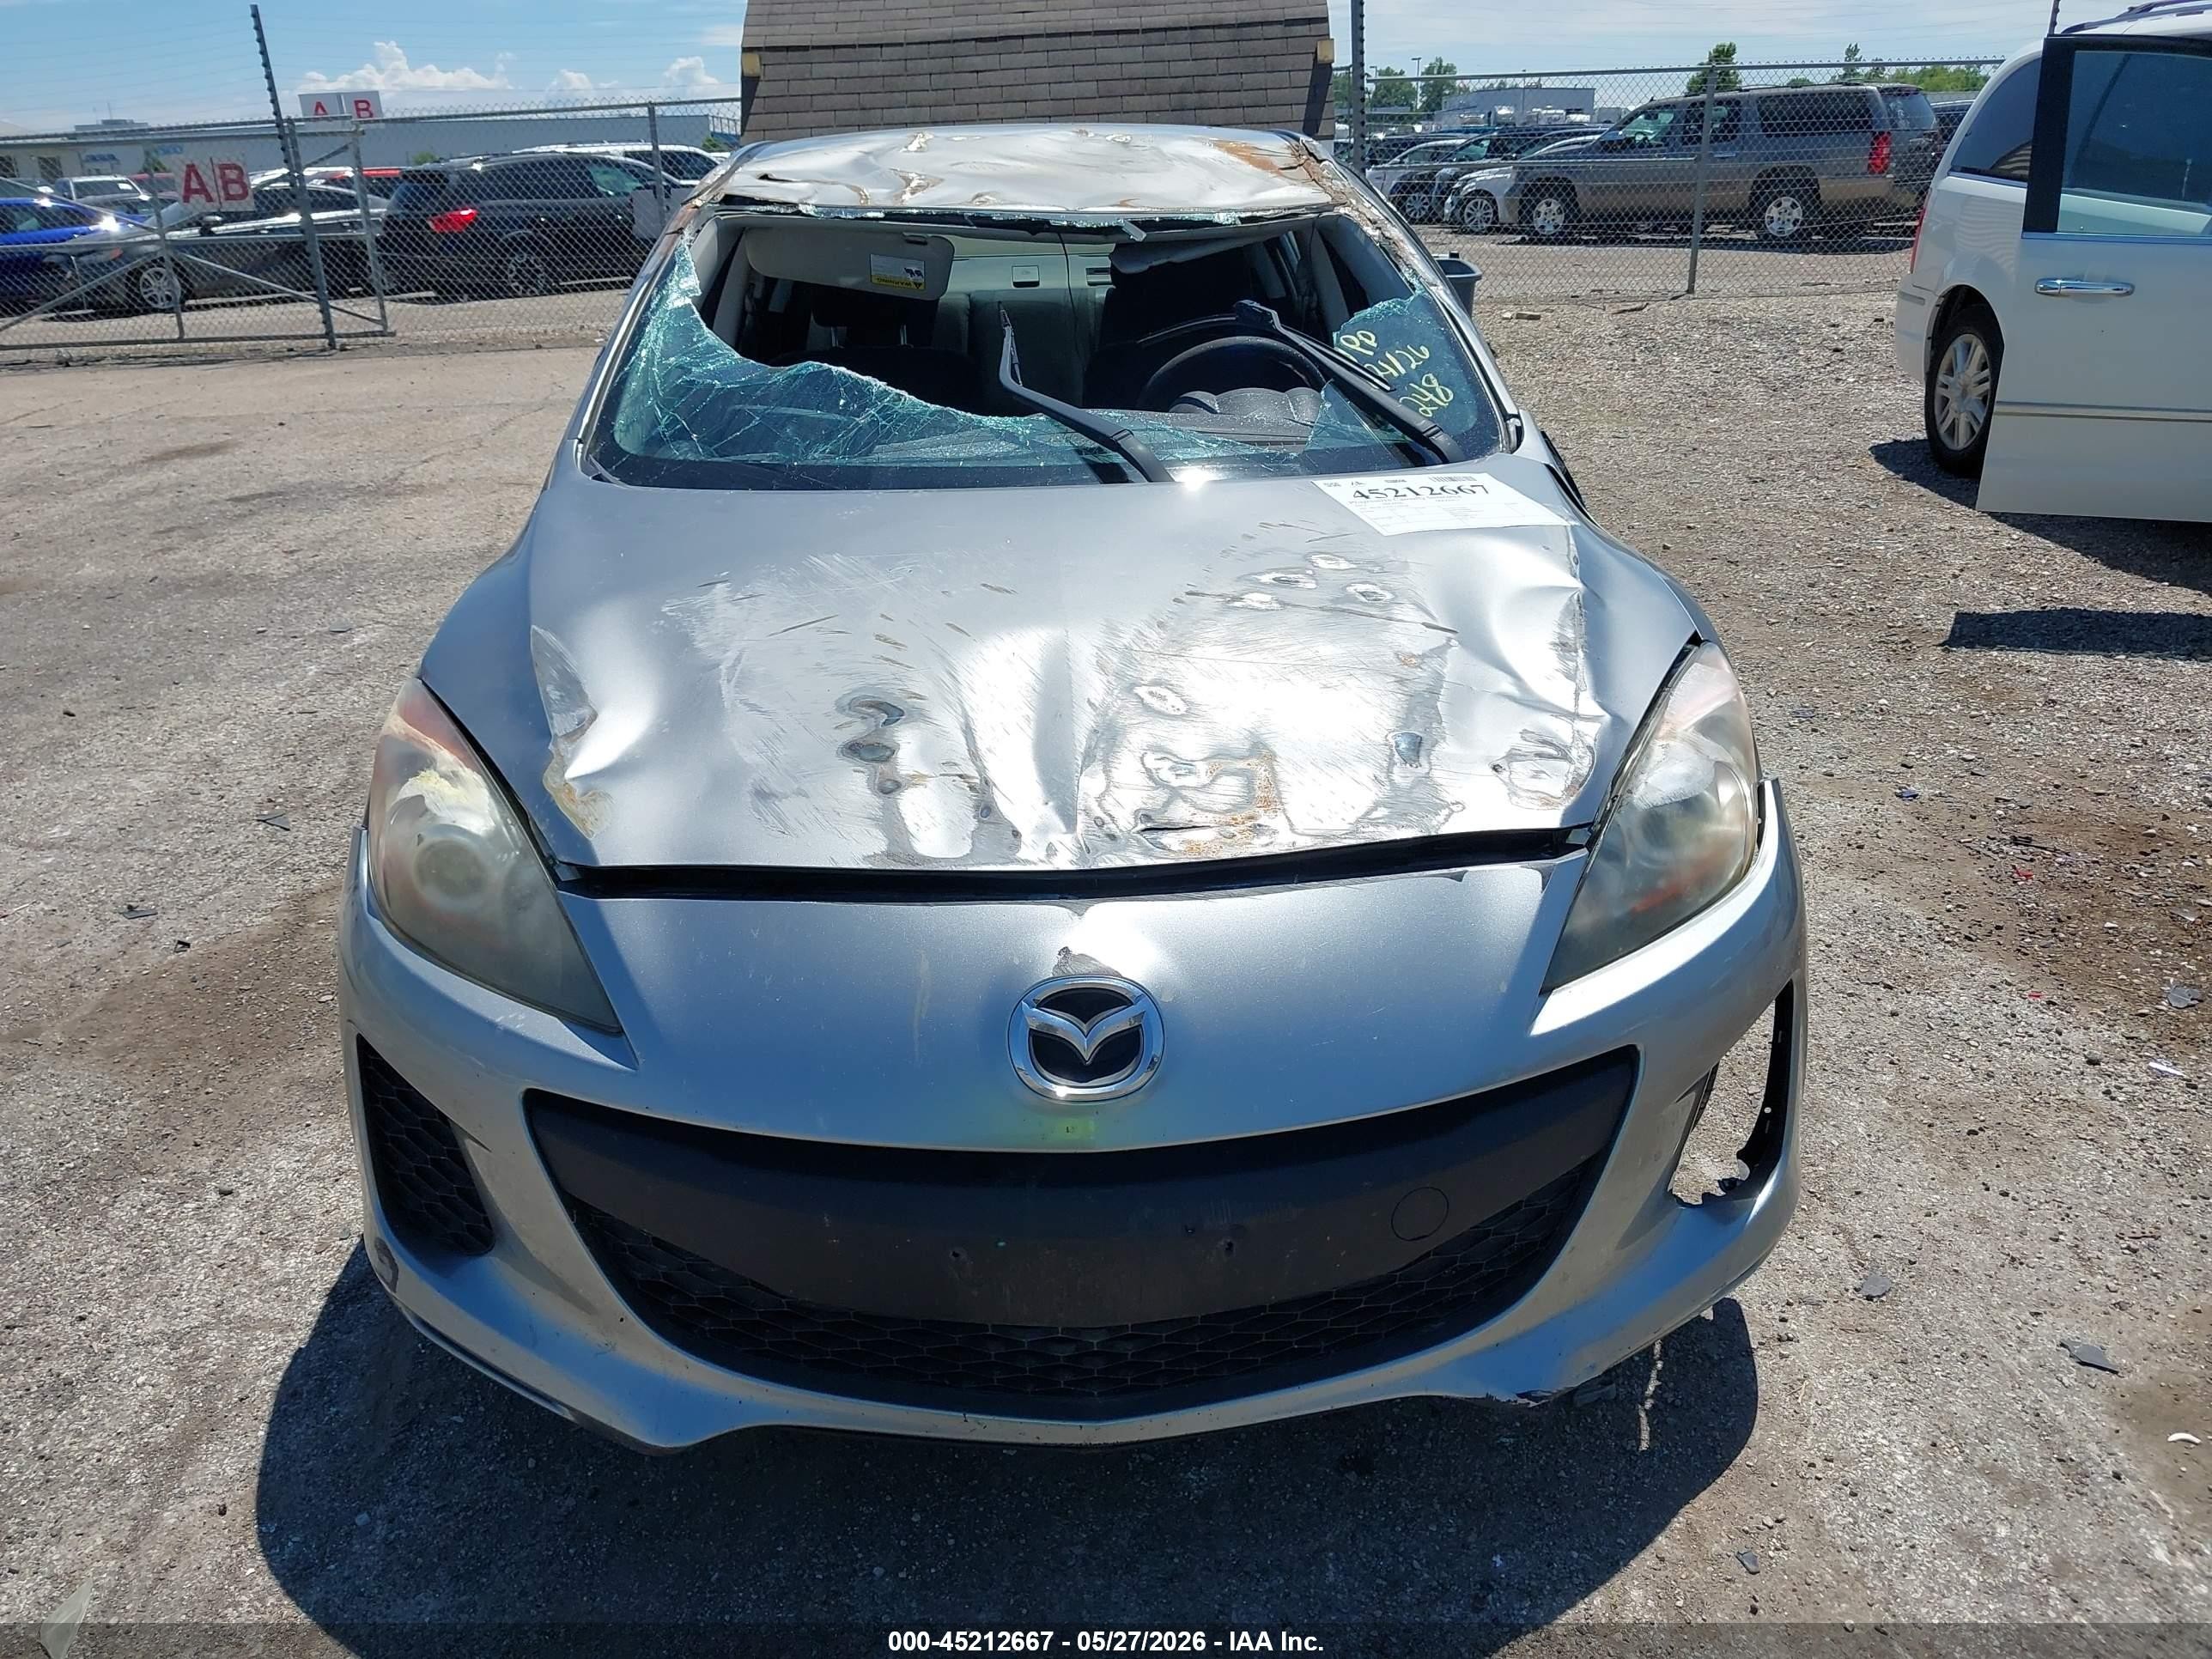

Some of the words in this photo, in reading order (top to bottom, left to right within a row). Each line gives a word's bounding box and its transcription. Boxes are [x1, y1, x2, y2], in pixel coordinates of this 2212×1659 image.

[313, 101, 330, 116] A
[354, 100, 374, 119] B
[182, 163, 214, 204] A
[217, 163, 249, 202] B
[1352, 484, 1489, 499] 45212667
